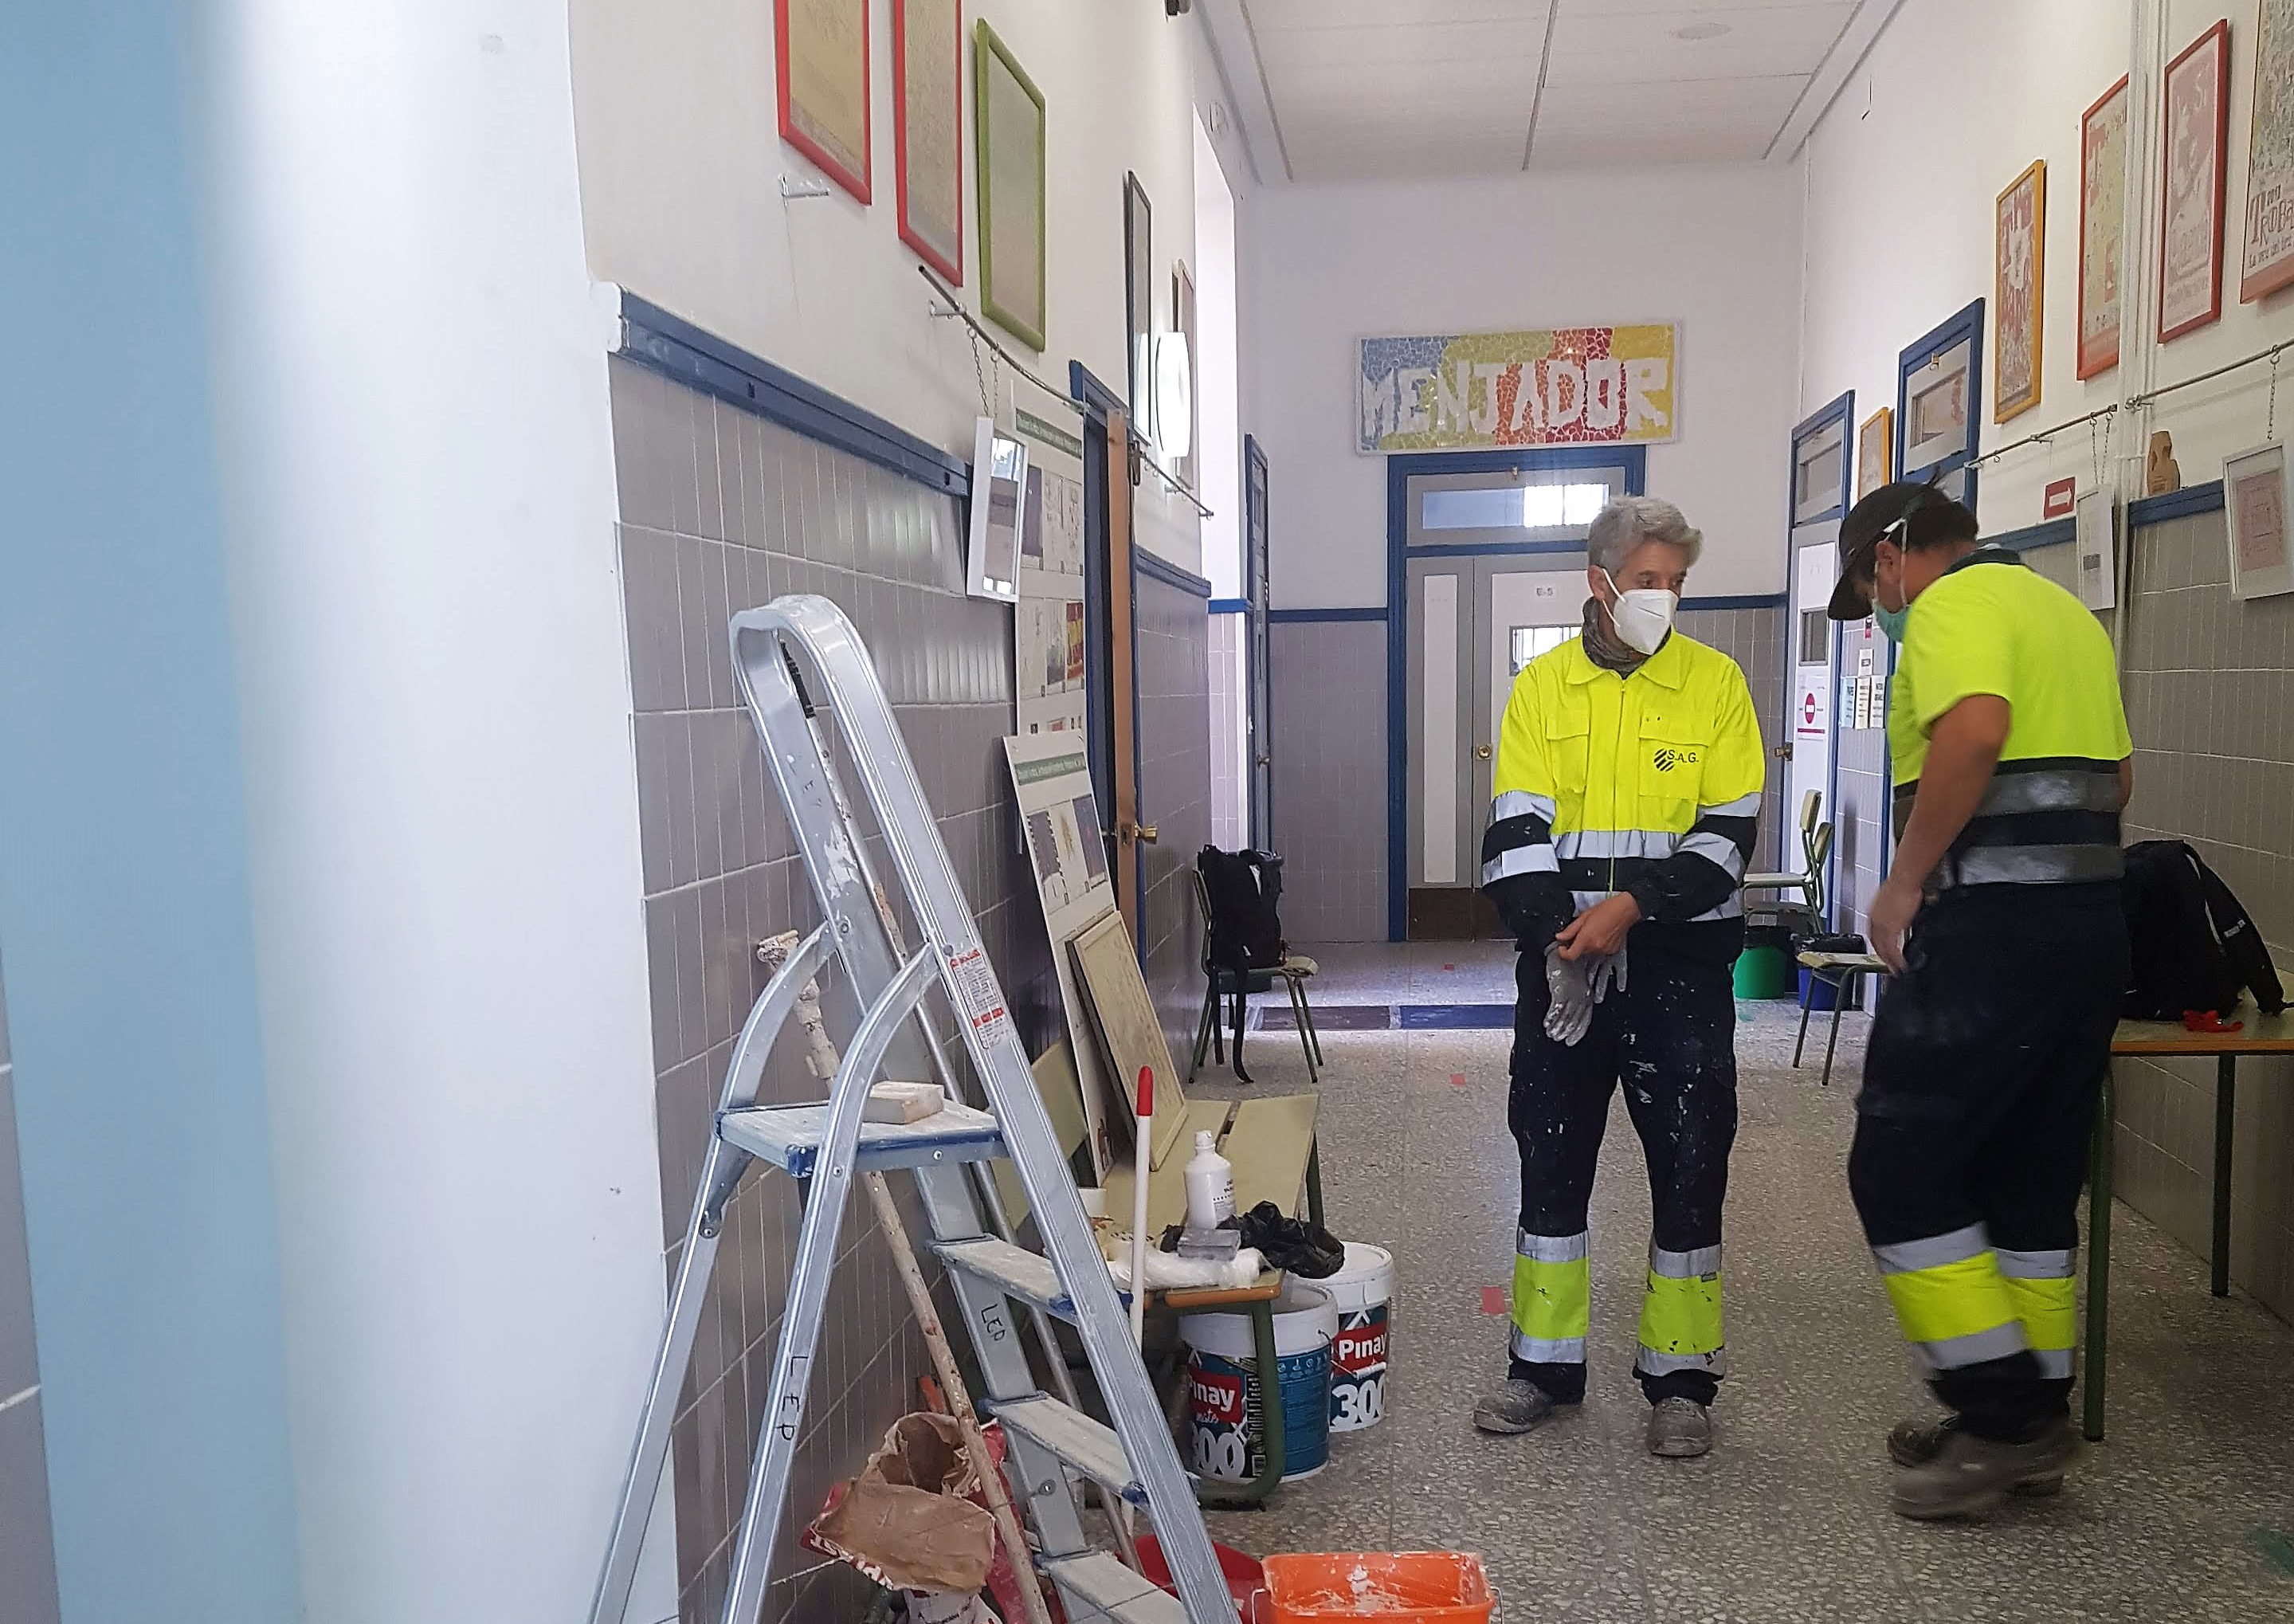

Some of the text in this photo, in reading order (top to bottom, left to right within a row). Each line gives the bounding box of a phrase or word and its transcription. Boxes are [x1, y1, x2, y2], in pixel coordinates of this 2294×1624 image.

[1362, 358, 1669, 437] MENJADOR
[1339, 1332, 1387, 1361] Pinay
[1331, 1371, 1386, 1425] 300
